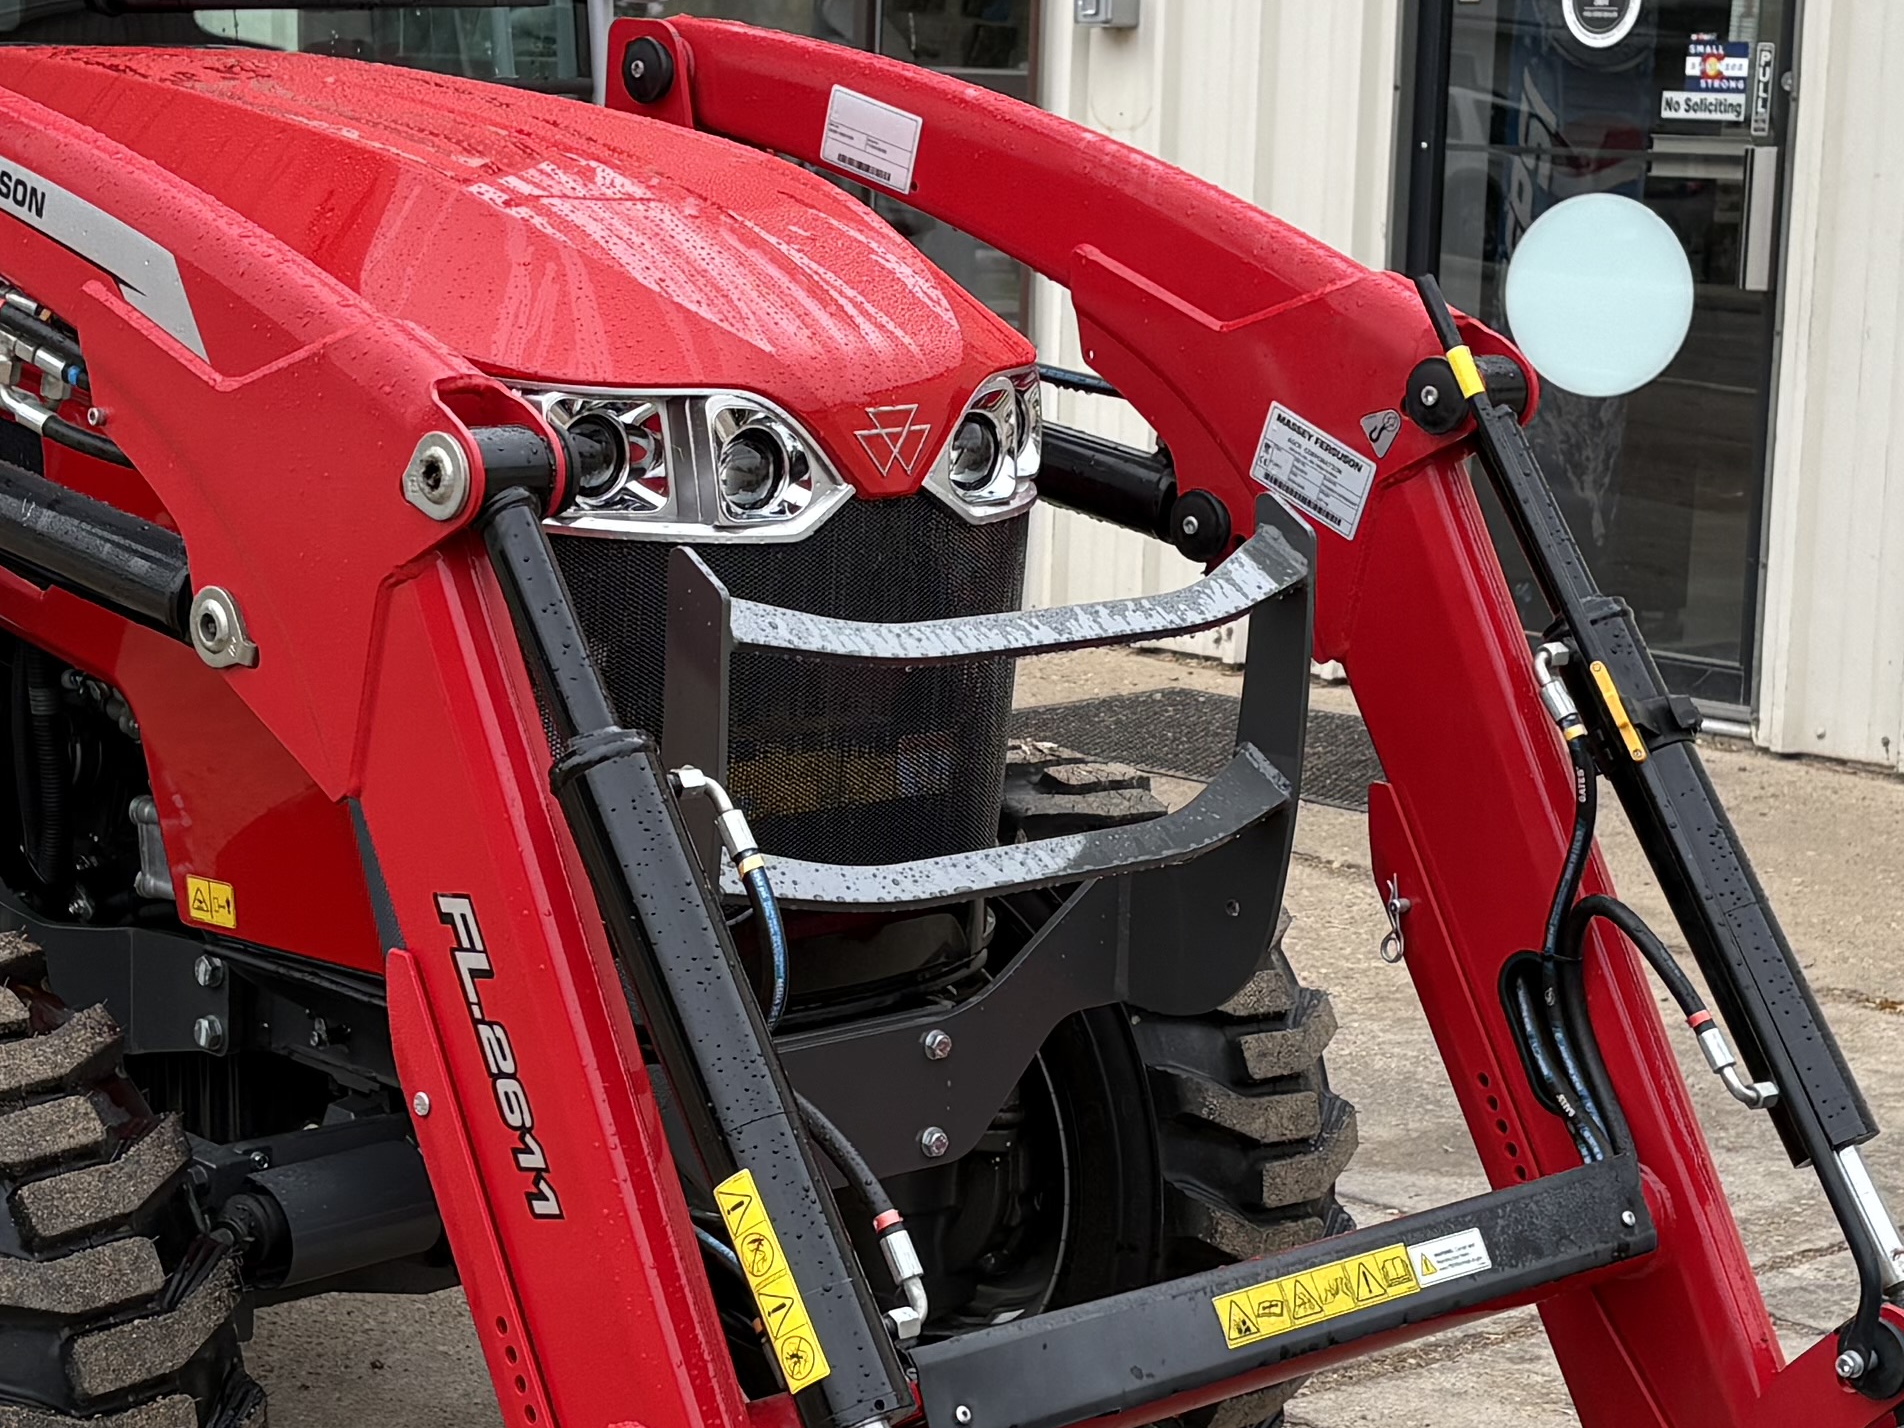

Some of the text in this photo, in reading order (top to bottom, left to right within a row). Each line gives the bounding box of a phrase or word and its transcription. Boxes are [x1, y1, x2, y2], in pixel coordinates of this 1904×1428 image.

[1689, 44, 1724, 54] SMALL
[1700, 79, 1745, 89] STRONG
[1757, 51, 1772, 112] PULL
[1664, 97, 1742, 118] No Soliciting
[1277, 413, 1314, 441] MASSEY
[1315, 437, 1364, 472] FERGUSON
[433, 892, 565, 1221] FL.2611
